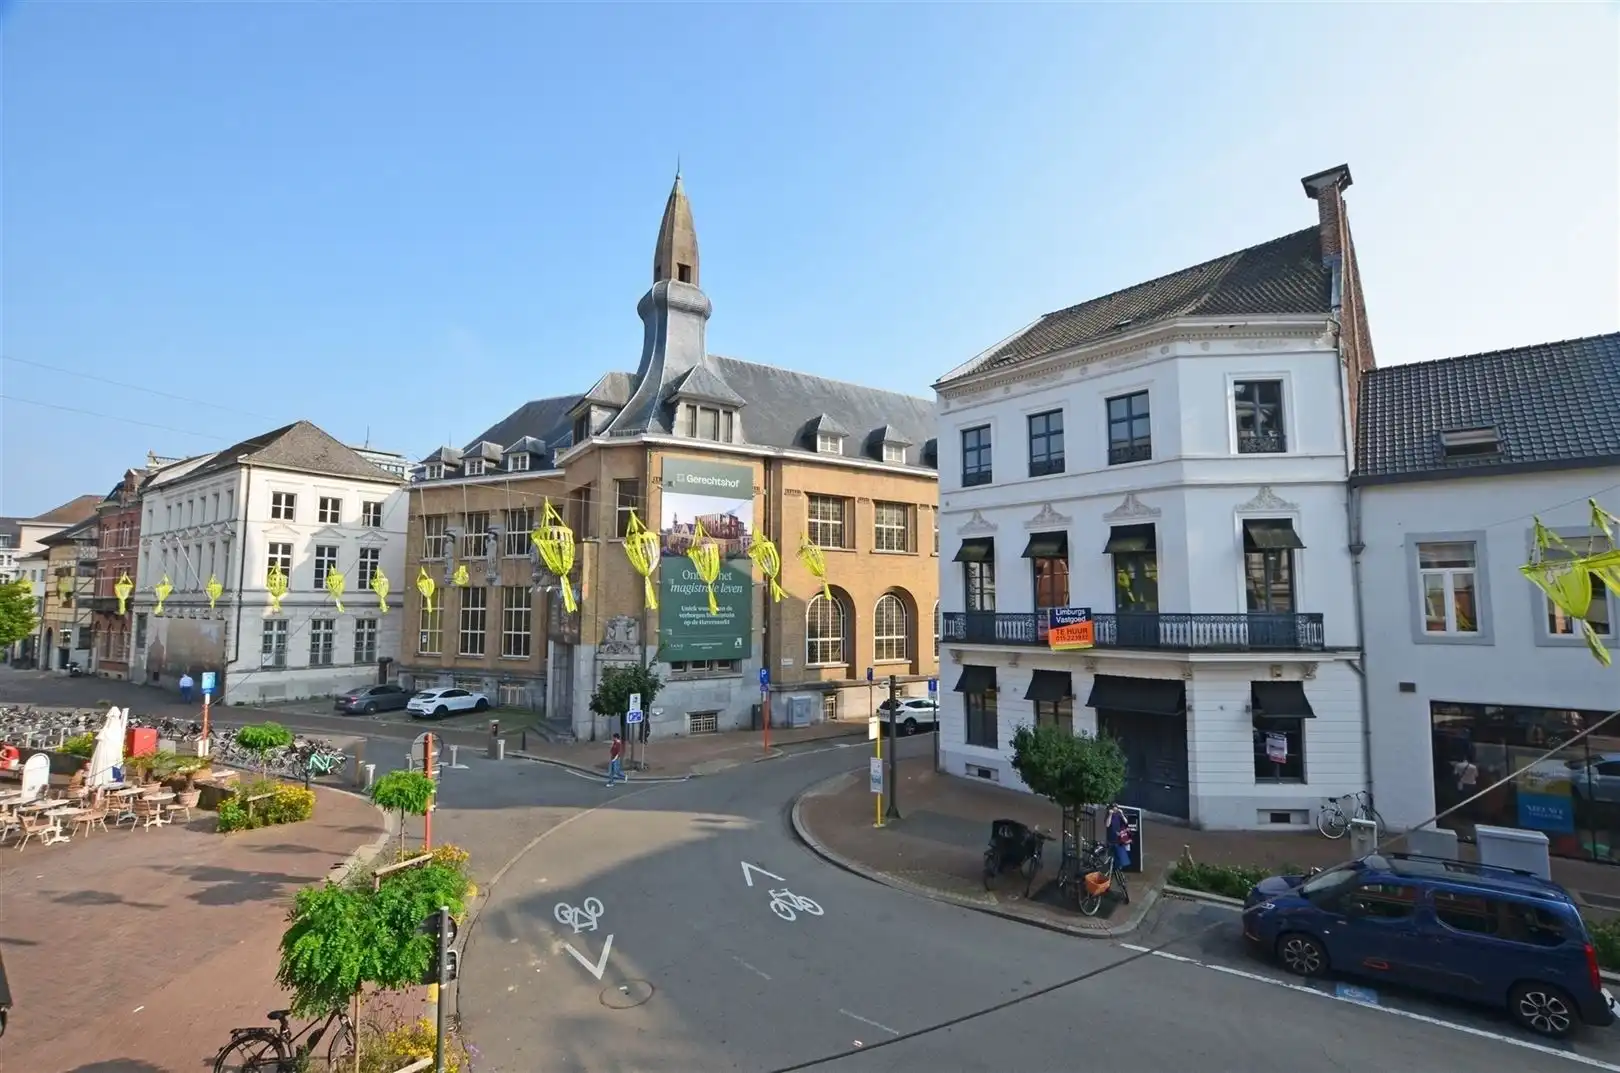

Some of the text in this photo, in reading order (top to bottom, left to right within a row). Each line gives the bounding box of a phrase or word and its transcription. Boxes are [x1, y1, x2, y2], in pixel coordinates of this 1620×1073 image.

[686, 474, 740, 487] Gerechtshof
[721, 583, 743, 593] leven
[1056, 616, 1086, 624] Vastgoed
[761, 669, 767, 678] P
